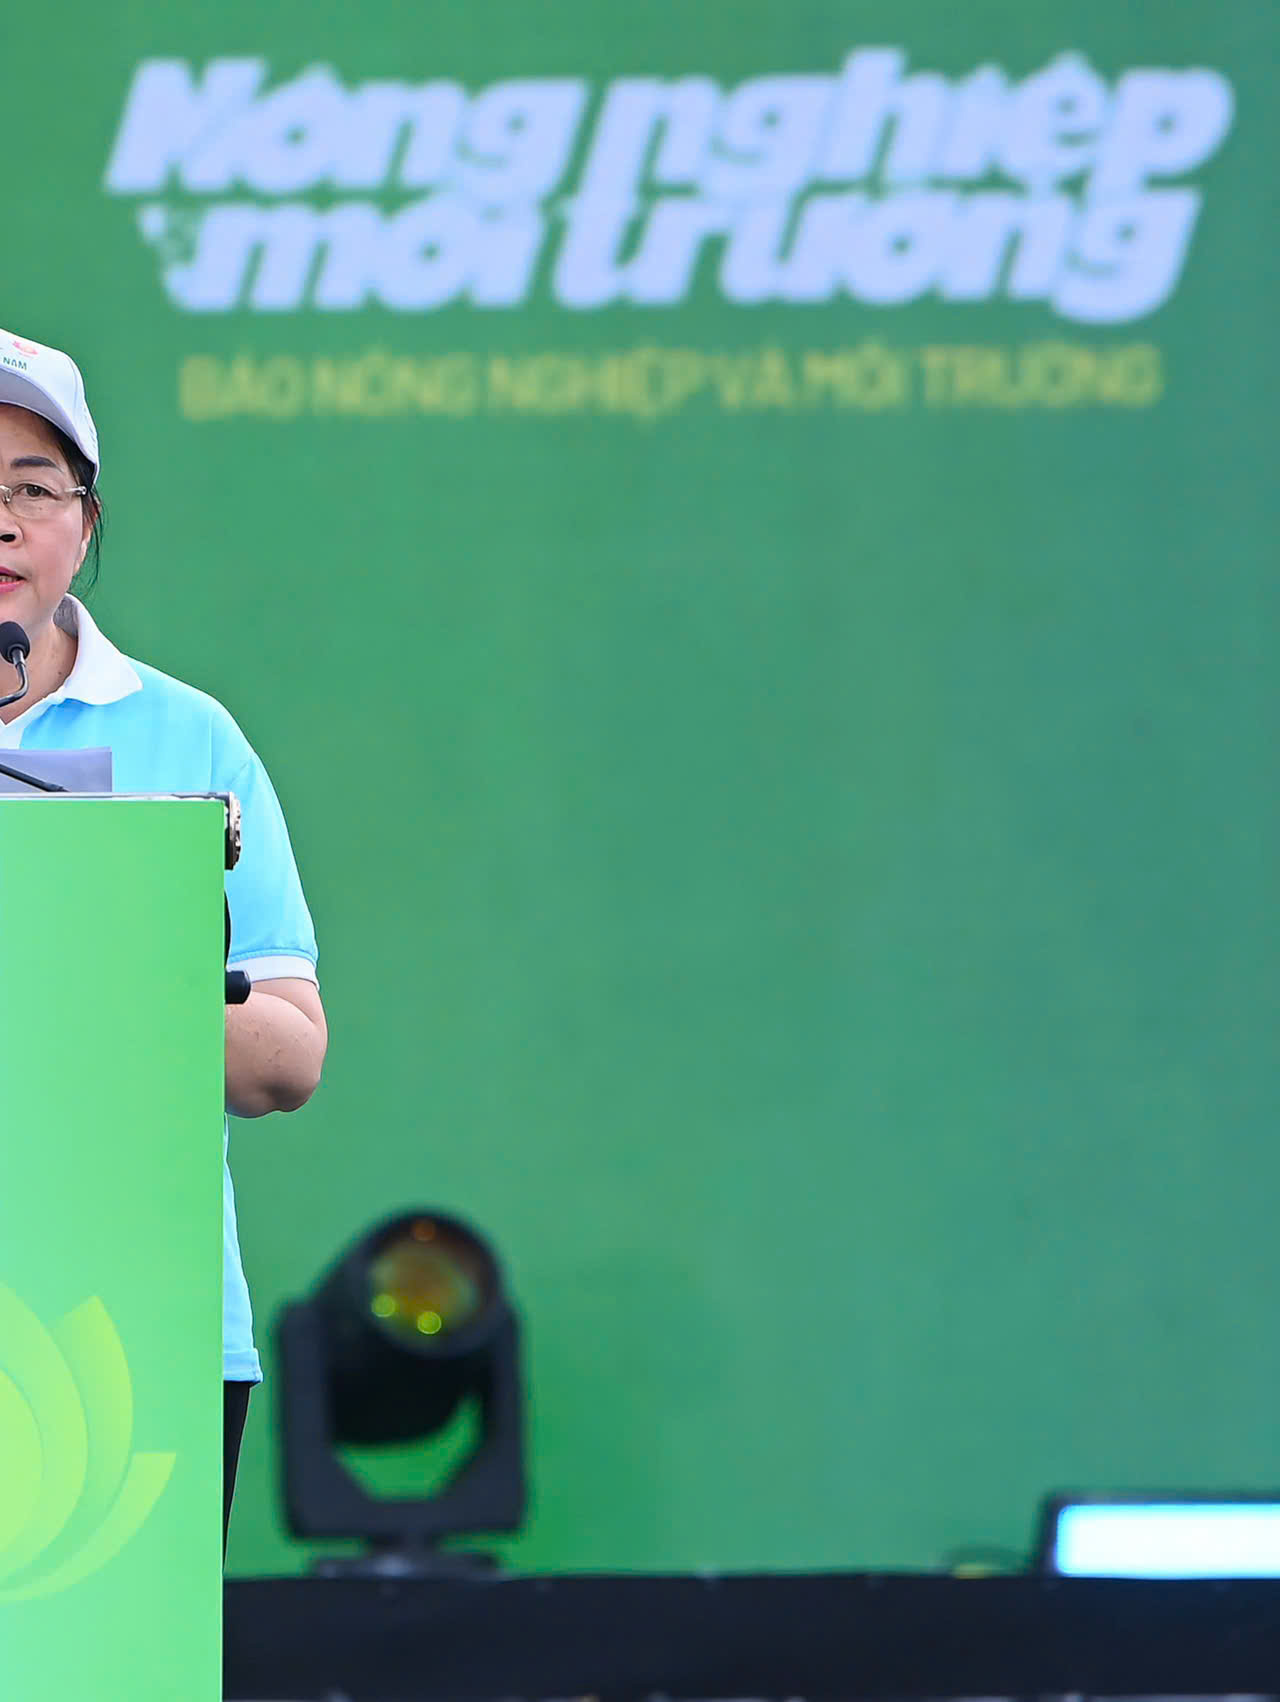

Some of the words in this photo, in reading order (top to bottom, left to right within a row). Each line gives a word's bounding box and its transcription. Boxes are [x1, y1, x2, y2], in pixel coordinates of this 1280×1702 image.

[104, 57, 588, 205] Nông
[3, 356, 27, 371] NAM
[178, 345, 305, 422] BÁO
[312, 342, 477, 420] NÔNG
[488, 340, 704, 428] NGHIỆP
[803, 336, 914, 412] MÔI
